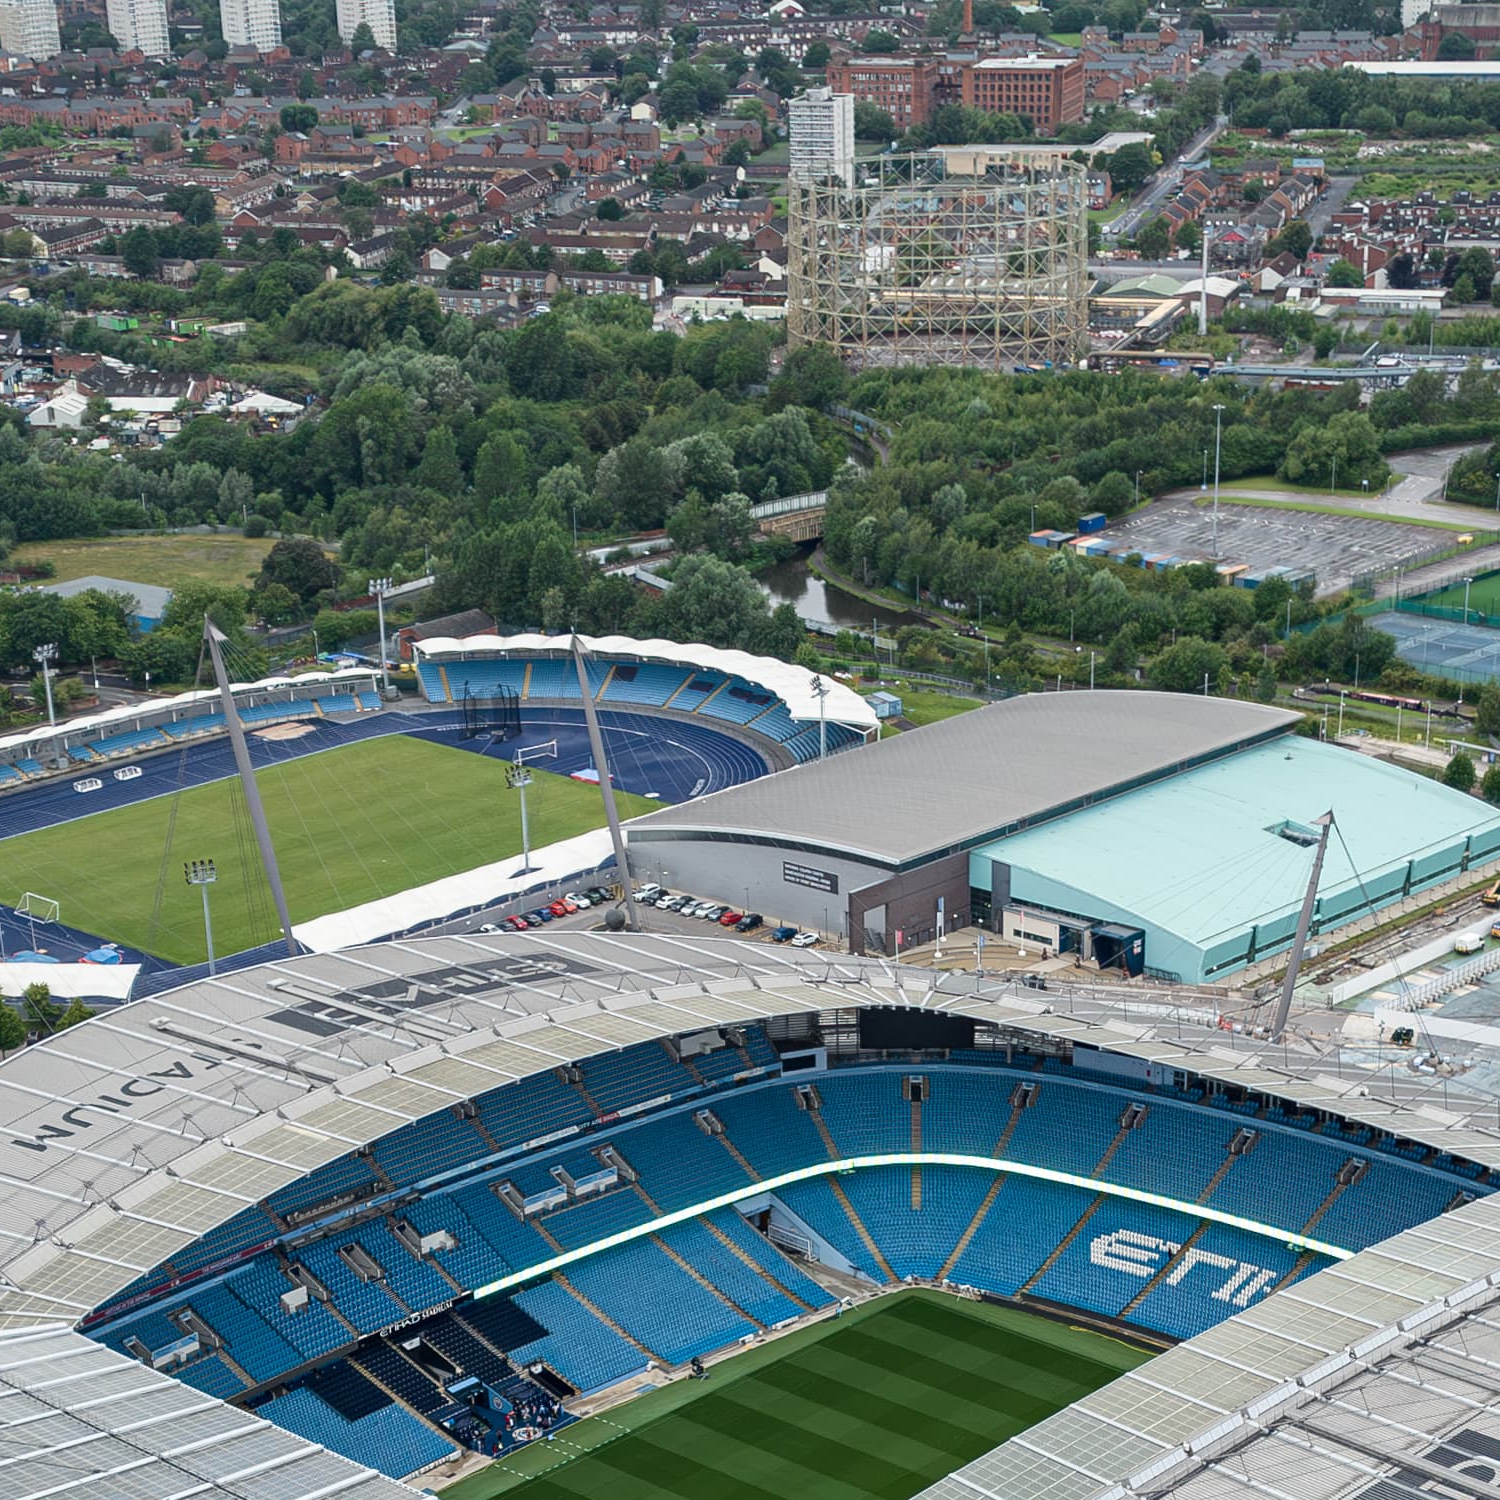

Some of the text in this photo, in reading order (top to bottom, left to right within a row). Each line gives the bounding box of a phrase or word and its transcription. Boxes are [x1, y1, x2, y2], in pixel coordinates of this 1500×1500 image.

[11, 1039, 263, 1153] TADIUM
[380, 1301, 453, 1338] ETIHAD STADIUM
